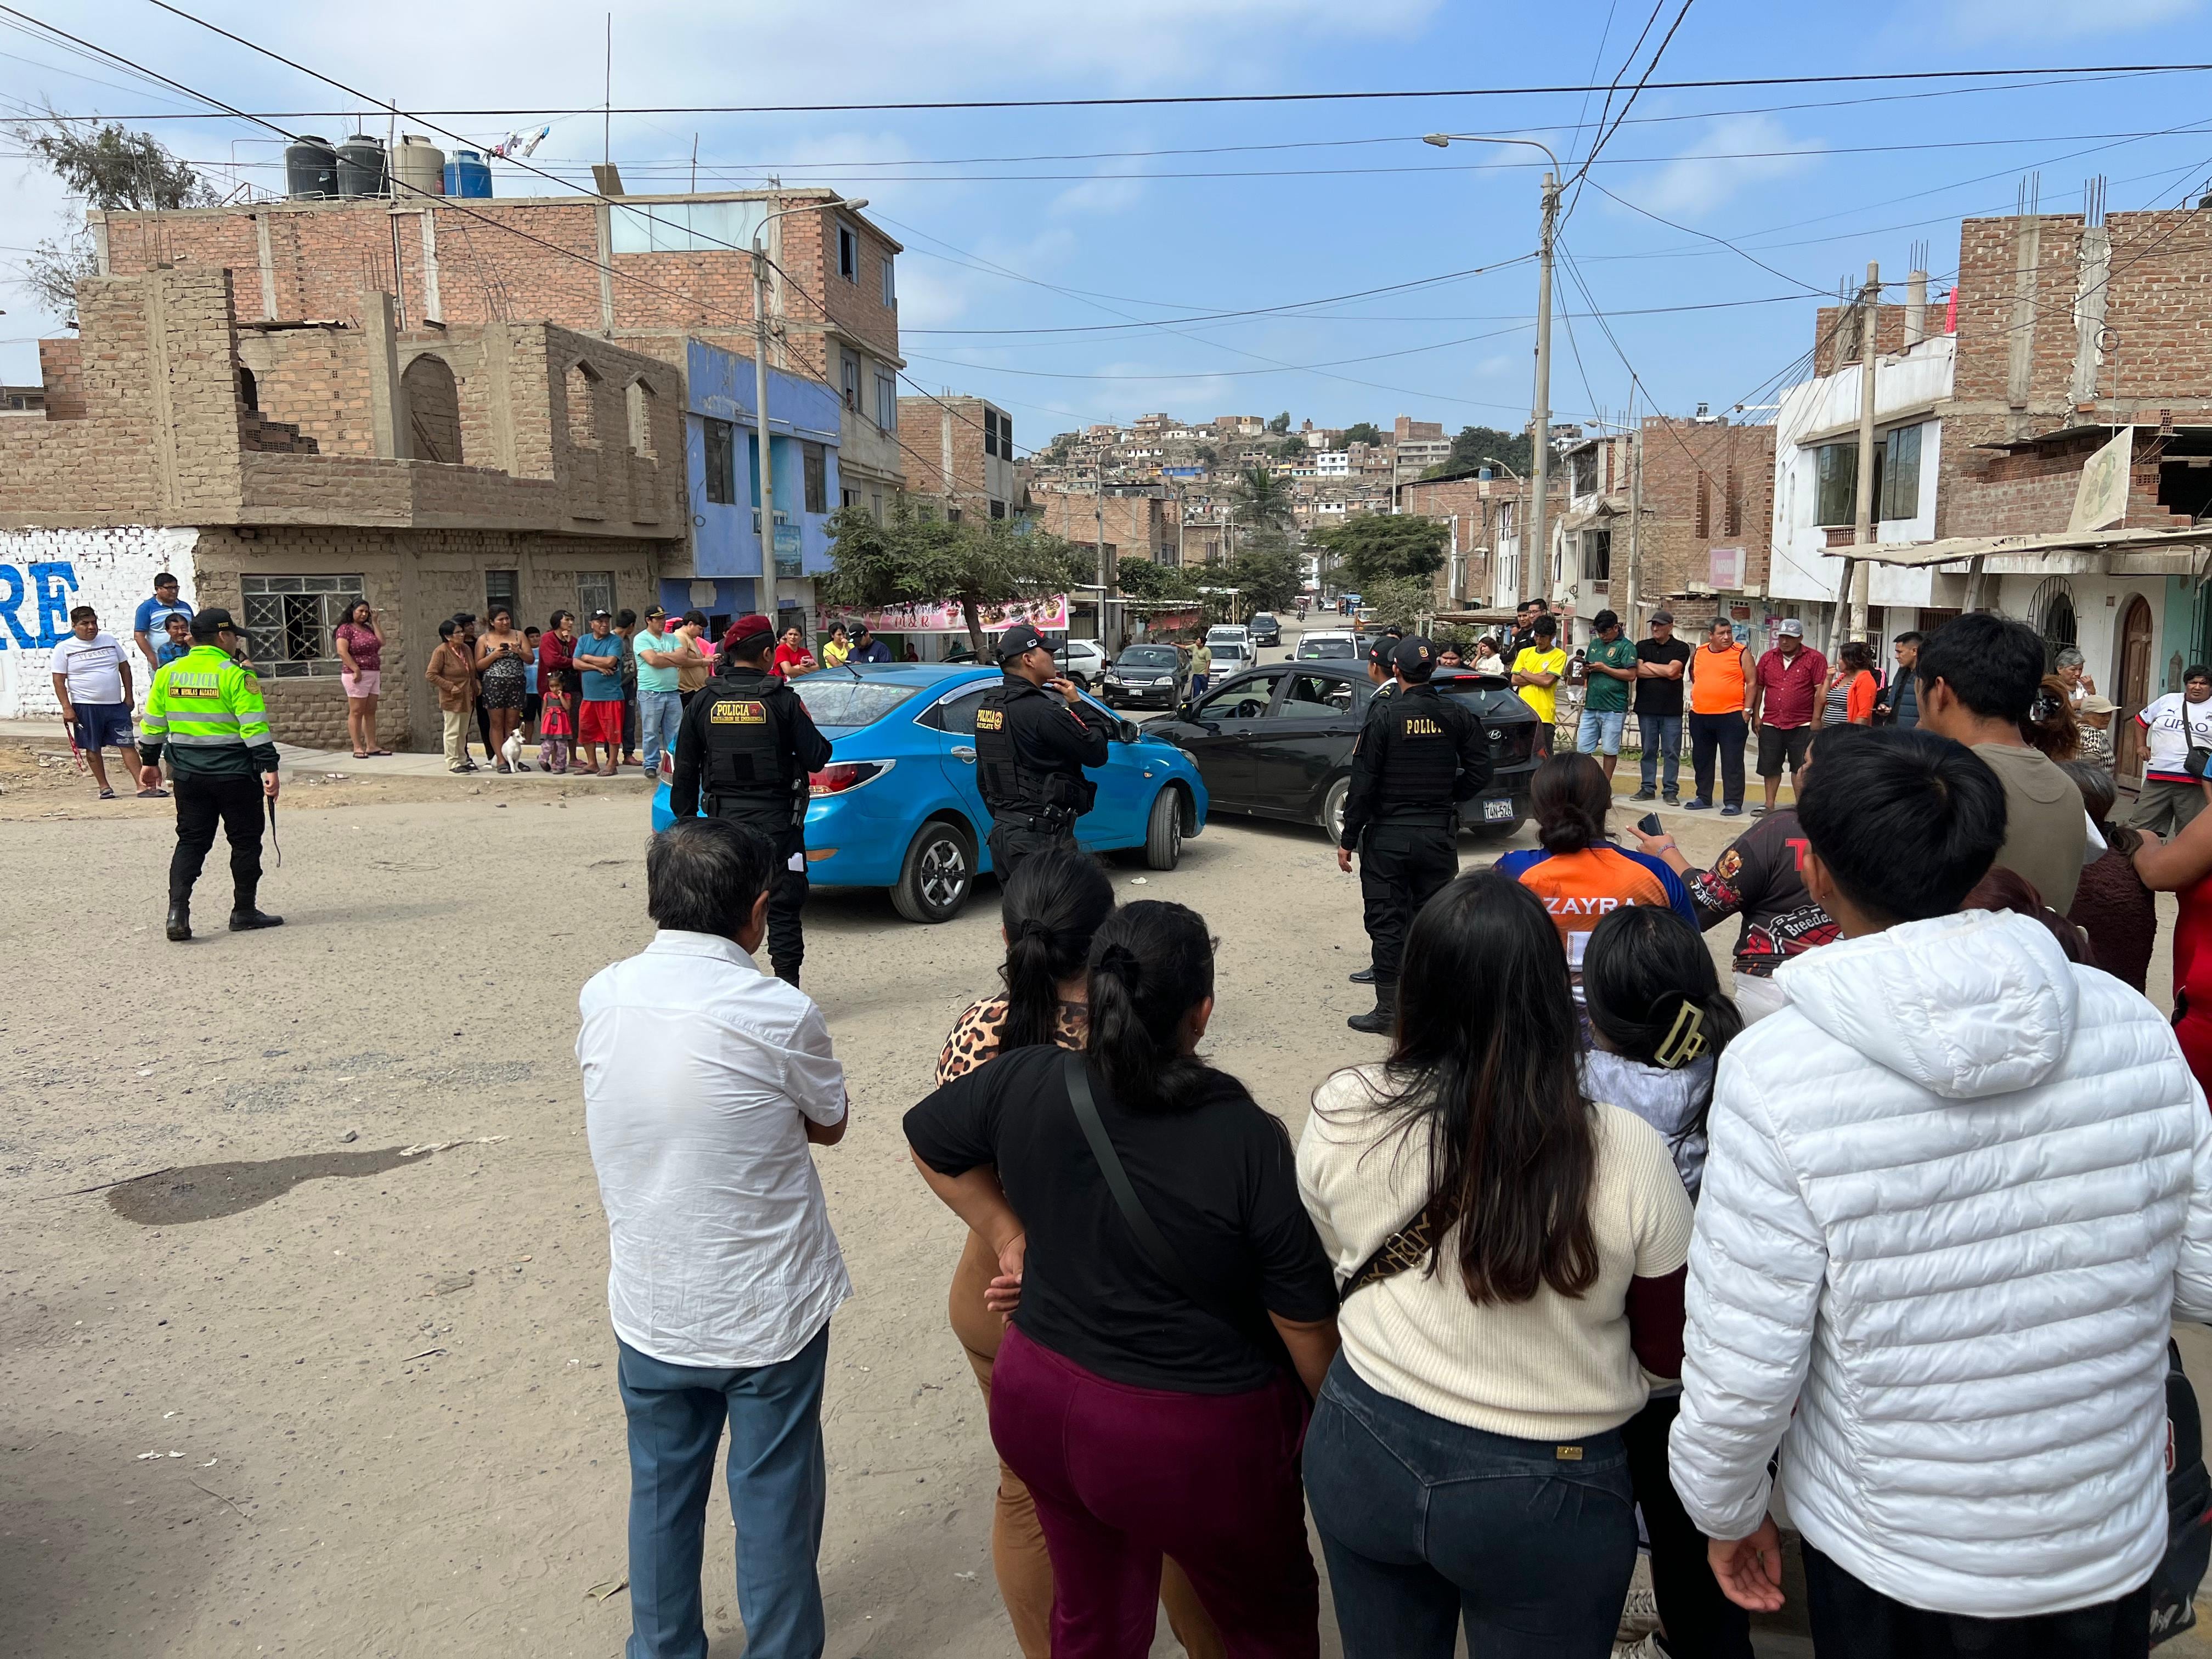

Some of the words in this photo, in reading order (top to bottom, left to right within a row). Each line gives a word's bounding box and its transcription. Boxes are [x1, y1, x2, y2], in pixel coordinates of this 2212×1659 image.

[170, 672, 219, 687] POLICIA
[716, 704, 750, 716] POLICIA
[977, 709, 995, 723] POLICIA
[1407, 719, 1444, 735] POLIC
[1485, 805, 1511, 819] T4N-526
[1784, 912, 1834, 937] Breede
